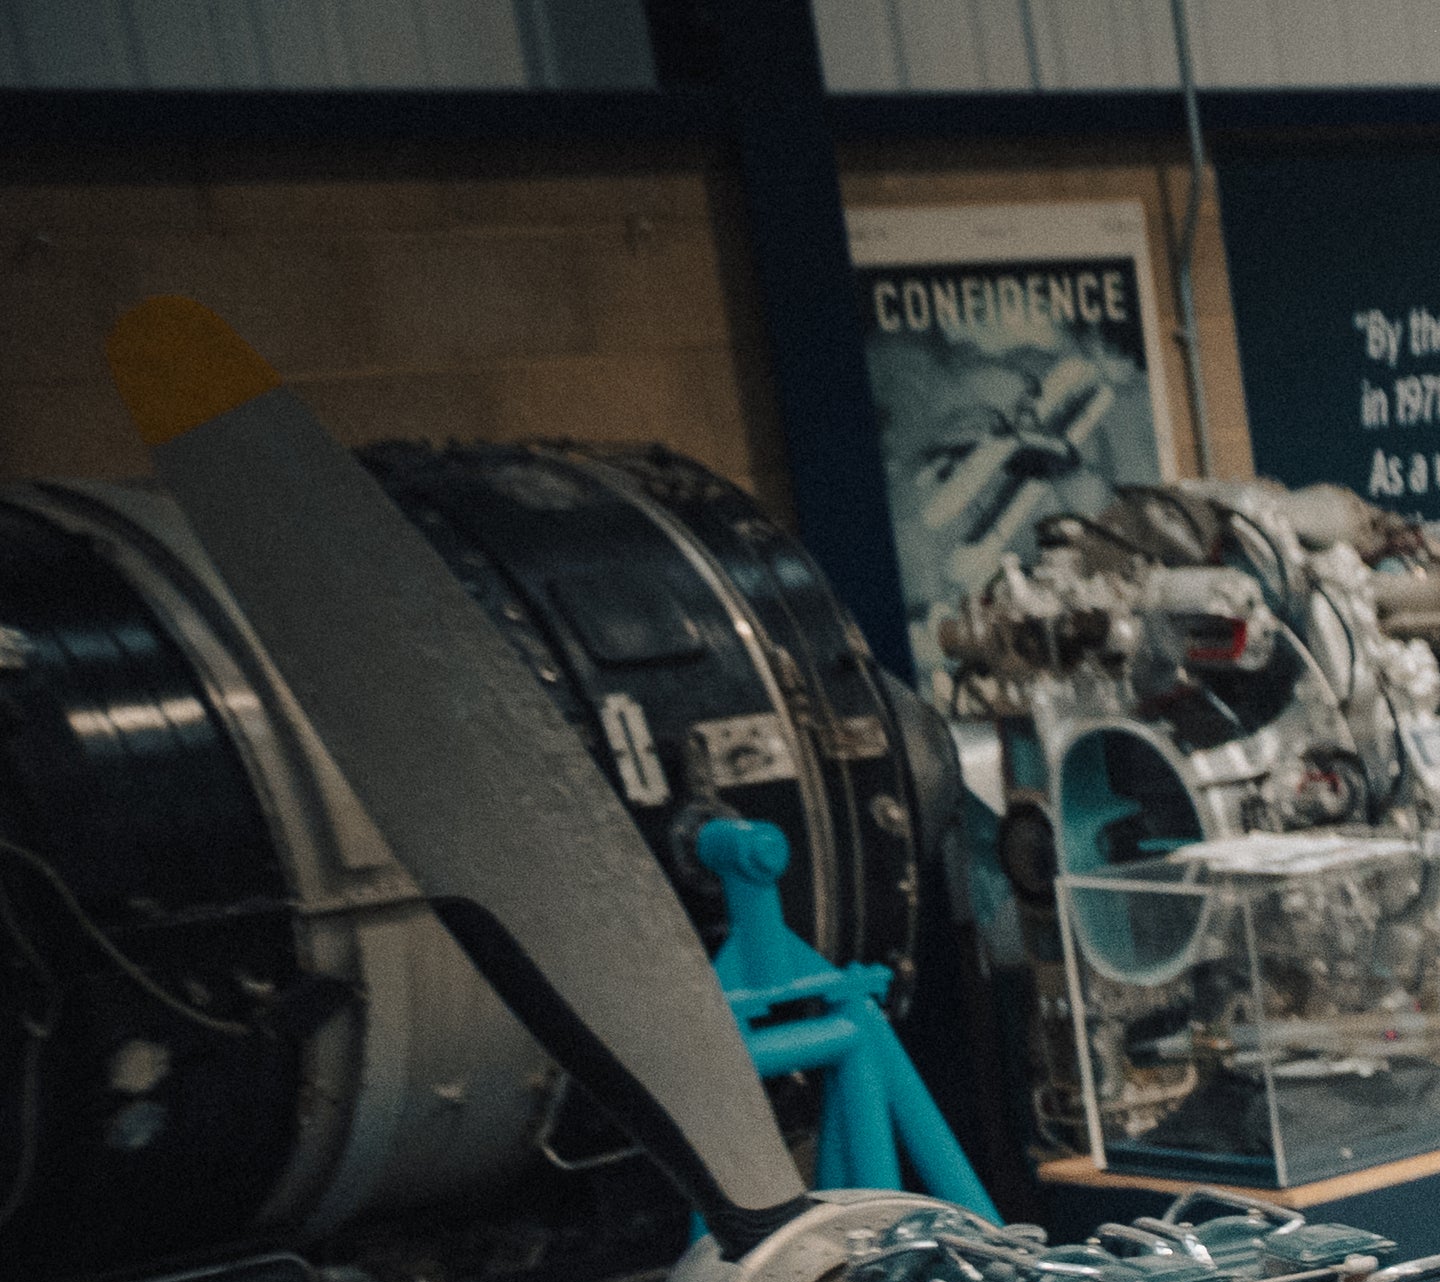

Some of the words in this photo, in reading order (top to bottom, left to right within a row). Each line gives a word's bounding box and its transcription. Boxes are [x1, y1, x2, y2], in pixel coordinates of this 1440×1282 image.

[874, 271, 1126, 333] CONFIDENCE
[1361, 379, 1389, 428] in
[1369, 449, 1404, 496] As
[1408, 453, 1428, 493] a
